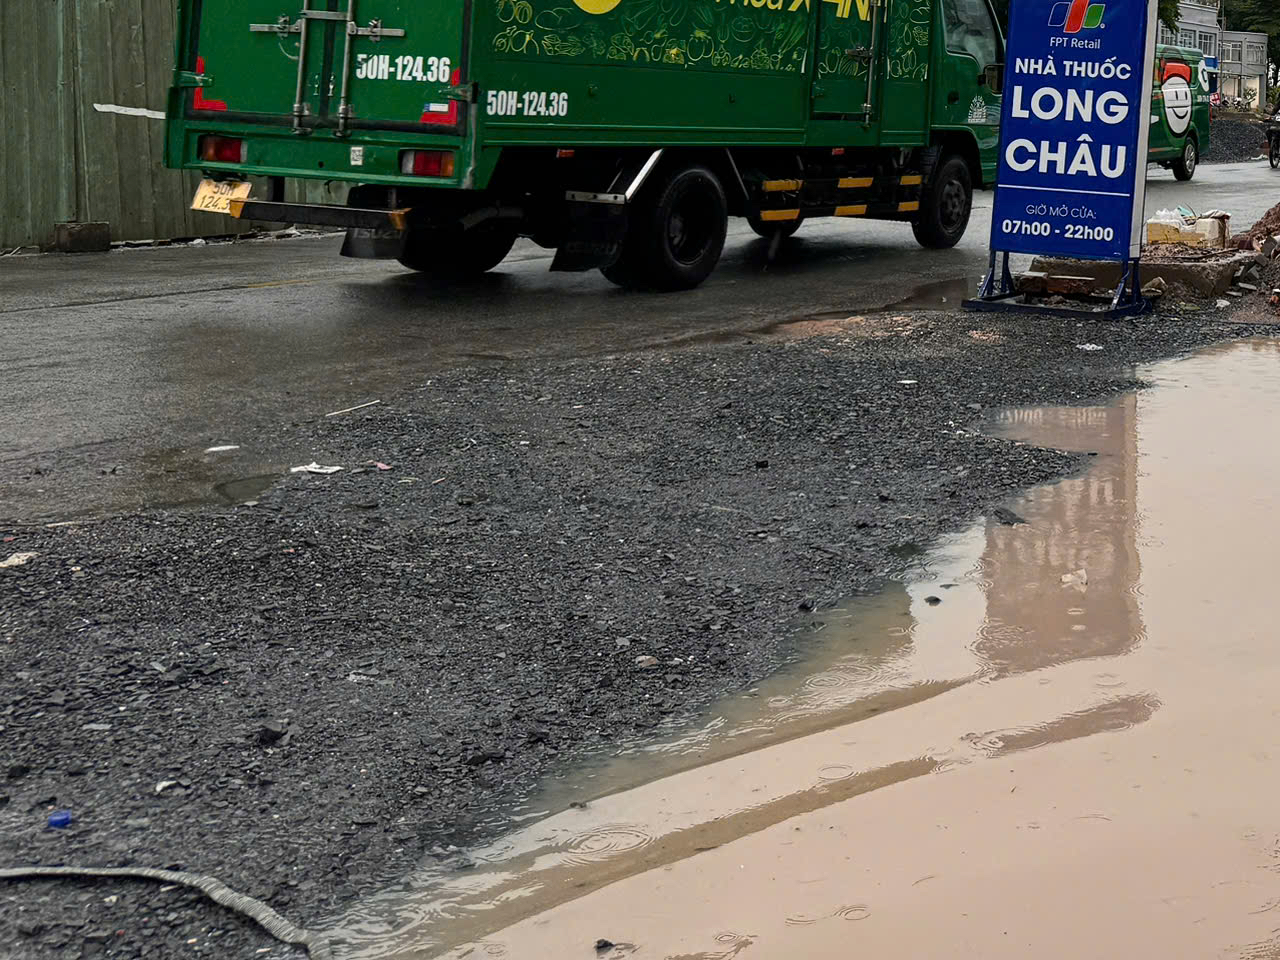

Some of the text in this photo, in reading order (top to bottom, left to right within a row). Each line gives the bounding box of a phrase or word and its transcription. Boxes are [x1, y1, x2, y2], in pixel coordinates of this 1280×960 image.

[1050, 36, 1101, 49] FPT Retail
[355, 53, 451, 83] 50H-124.36
[1014, 54, 1132, 79] NHÀ THUỐC
[486, 90, 569, 117] 50H-124.36
[1011, 85, 1129, 125] LONG
[1005, 133, 1127, 178] CHÂU
[199, 194, 230, 210] 124.3
[1026, 201, 1097, 219] GIỜ MỞ CỬA:
[1002, 220, 1051, 236] 07h00
[1064, 224, 1114, 241] 22h00
